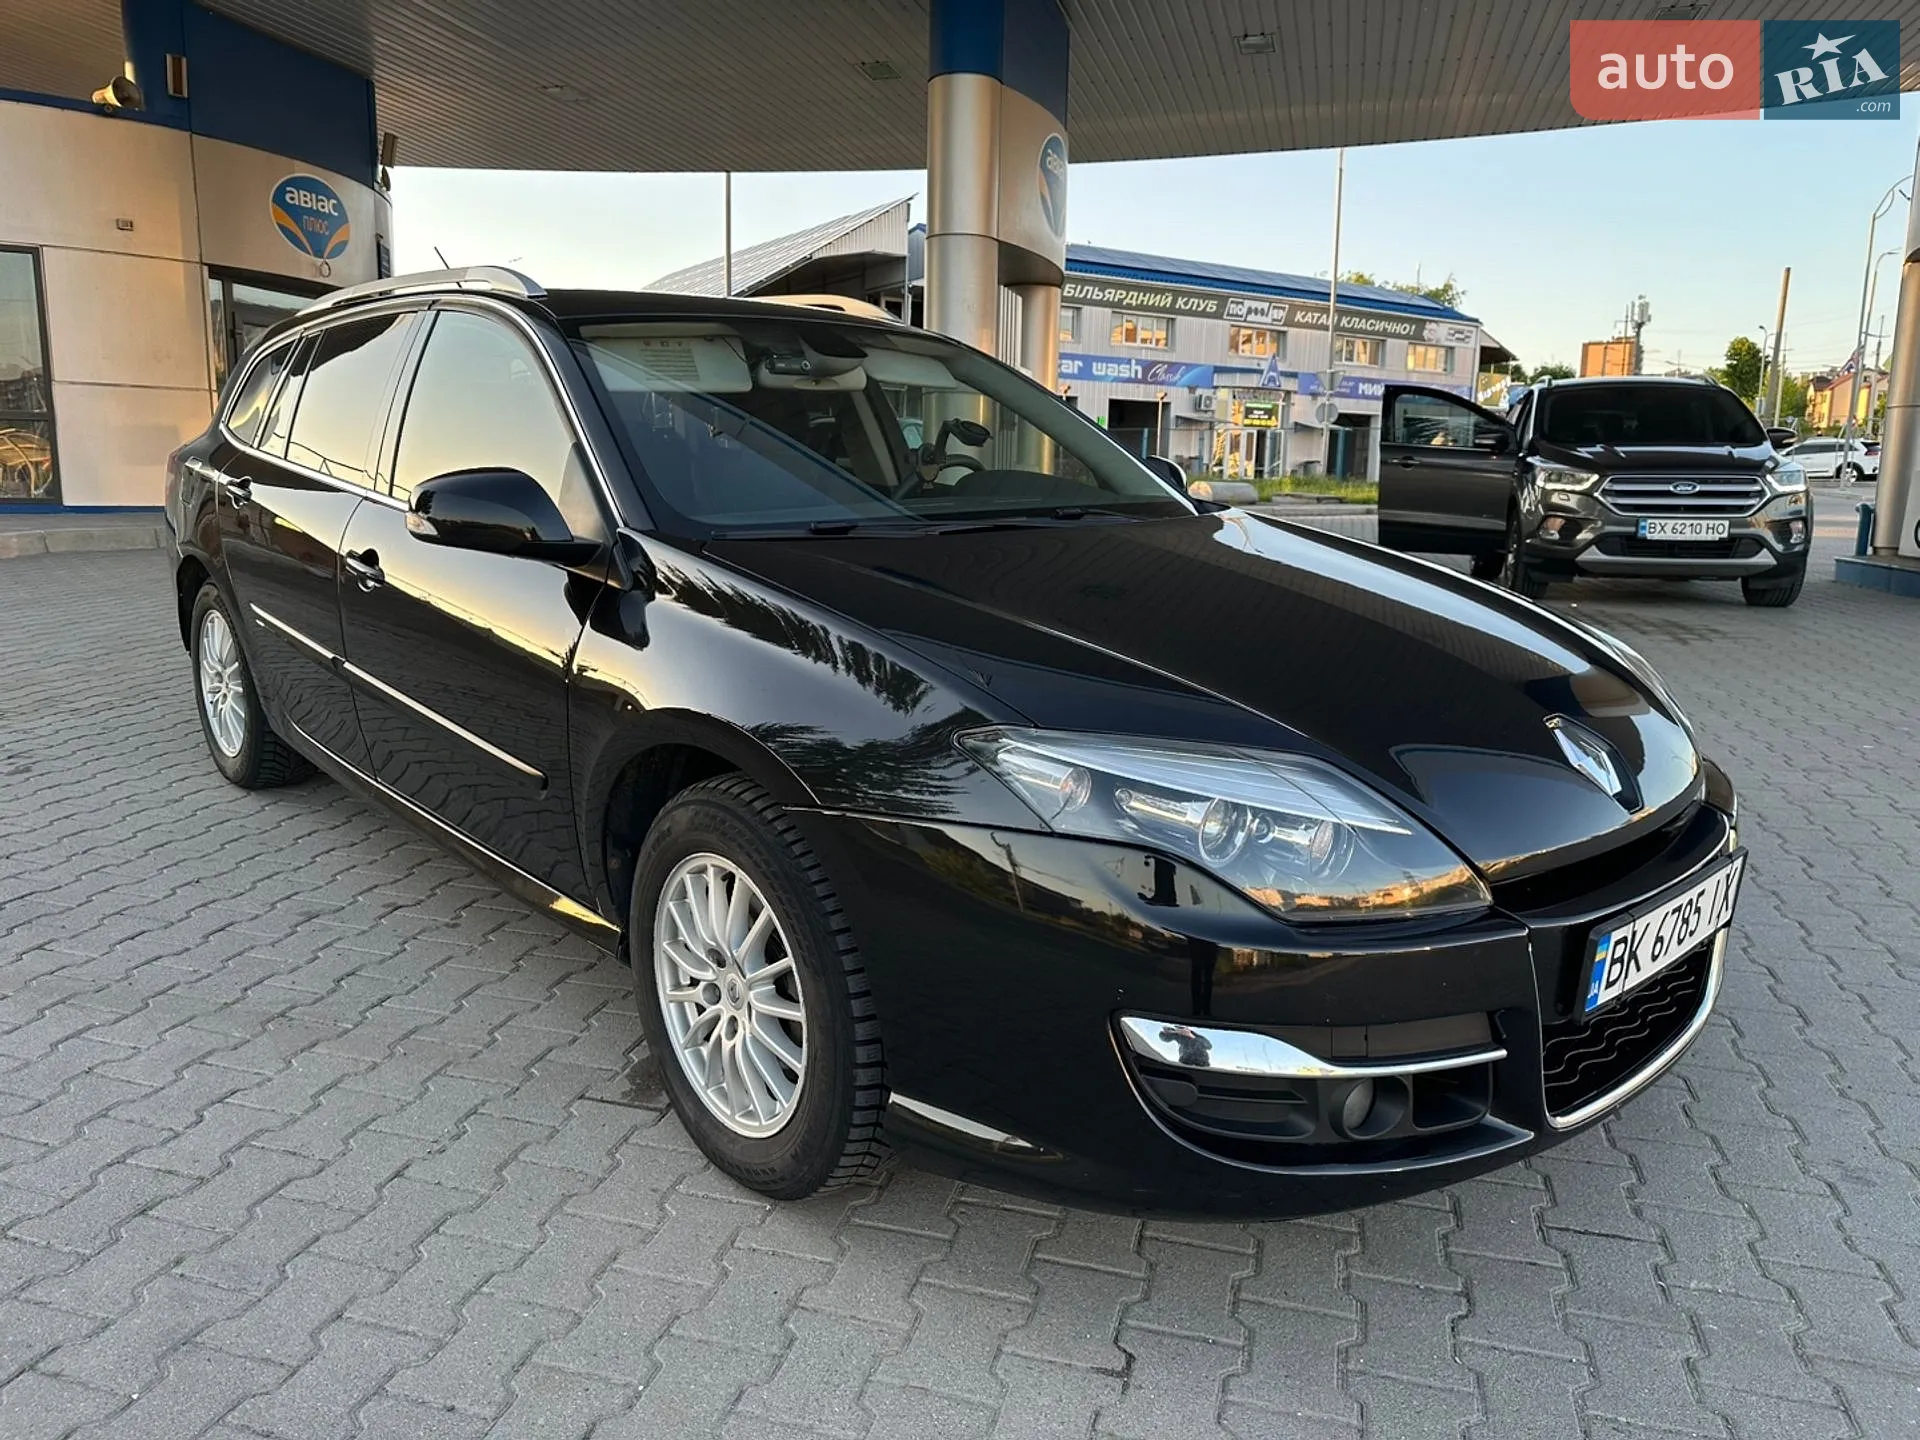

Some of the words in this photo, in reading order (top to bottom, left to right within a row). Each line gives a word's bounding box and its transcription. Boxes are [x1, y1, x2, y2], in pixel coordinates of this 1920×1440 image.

[1062, 283, 1174, 308] БІЛЬЯРДНИЙ
[1175, 296, 1218, 313] КЛУБ
[1340, 315, 1416, 336] КЛАСИЧНО!
[1058, 359, 1084, 374] ar
[1092, 359, 1143, 380] wash
[1647, 522, 1668, 535] BX
[1670, 522, 1703, 535] 6210
[1705, 522, 1727, 535] HO
[1605, 922, 1650, 990] BK
[1651, 888, 1706, 963] 6785
